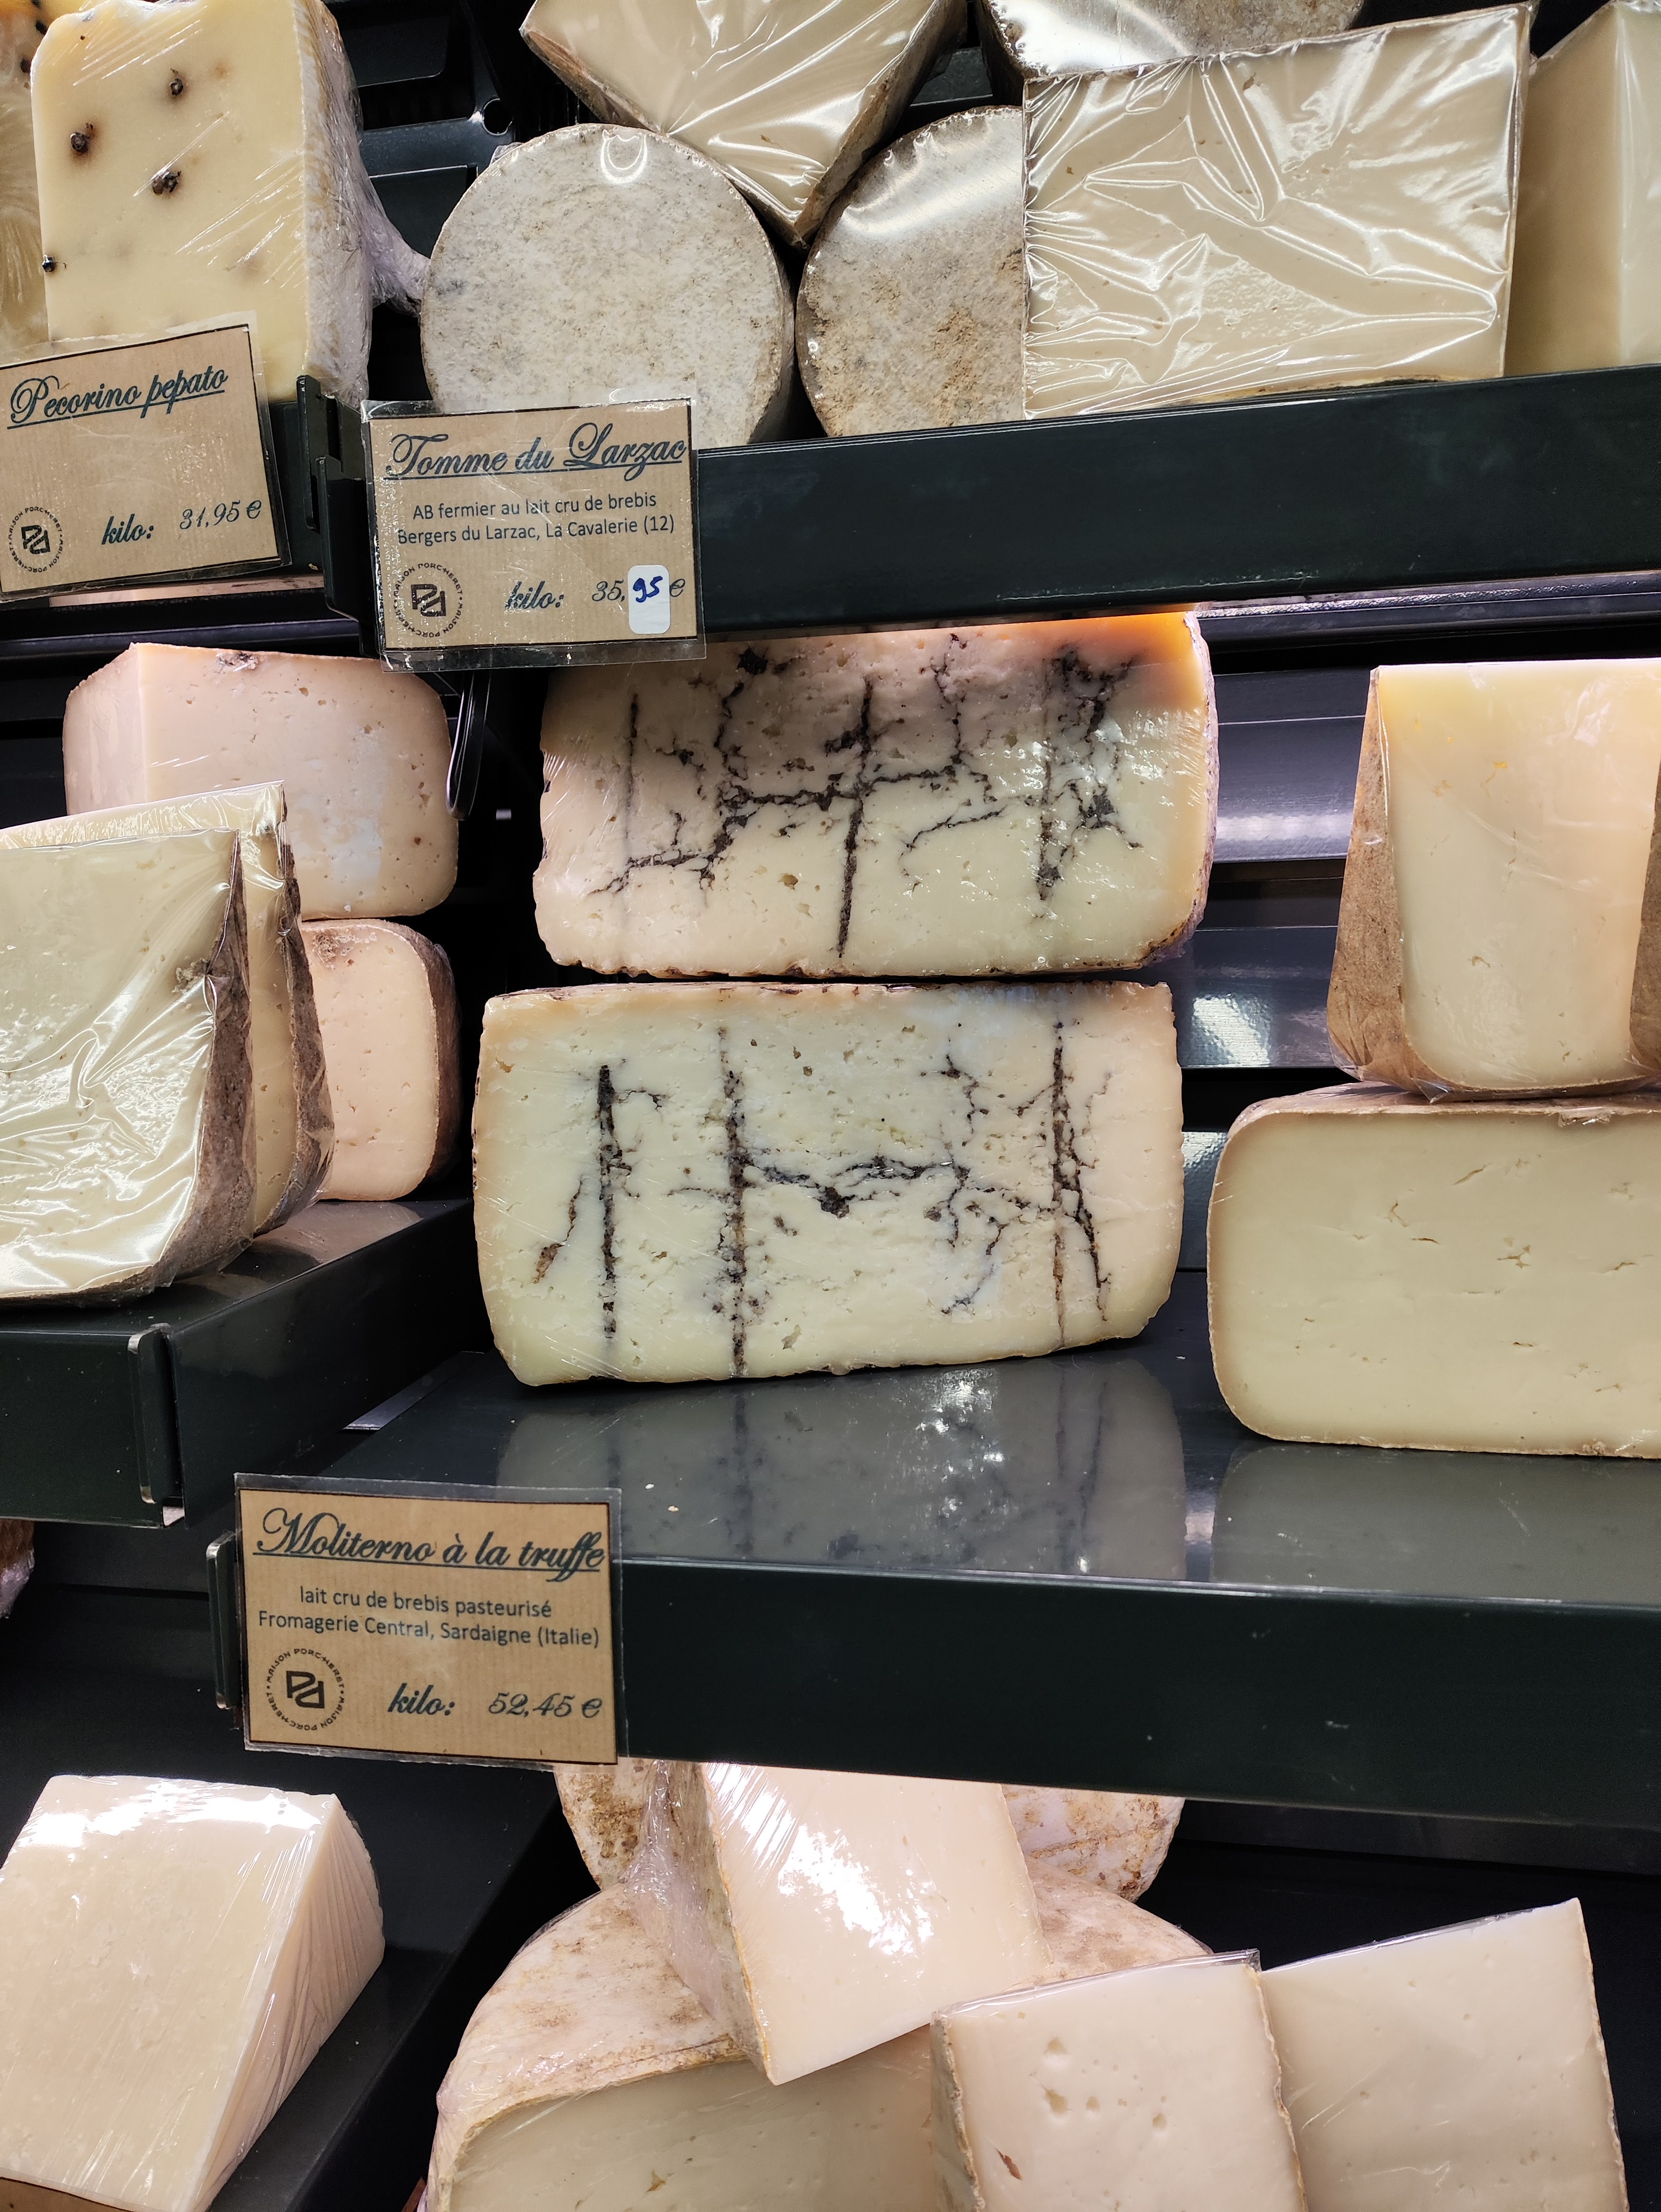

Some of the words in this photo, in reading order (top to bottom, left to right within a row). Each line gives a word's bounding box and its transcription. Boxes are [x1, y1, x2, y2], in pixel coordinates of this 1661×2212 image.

[11, 376, 141, 424] Pecorino
[140, 365, 228, 418] pepato
[386, 434, 507, 477] Tomme
[515, 437, 554, 470] du
[564, 422, 686, 481] Larzac
[413, 504, 433, 520] AB
[439, 501, 496, 518] fermier
[501, 501, 520, 515] au
[526, 499, 550, 515] lait
[554, 500, 580, 513] cru
[585, 495, 603, 511] de
[608, 492, 656, 509] brebis
[101, 514, 154, 544] kilo:
[398, 529, 456, 547] Bergers
[462, 523, 480, 542] du
[487, 522, 540, 542] Larzac,
[546, 524, 562, 537] La
[568, 517, 638, 537] Cavalerie
[644, 516, 675, 534] (12)
[505, 581, 565, 609] kilo:
[257, 1508, 435, 1563] Moliterno
[443, 1534, 467, 1564] à
[476, 1531, 510, 1568] la
[519, 1531, 606, 1582] truffe
[299, 1586, 326, 1604] lait
[332, 1590, 360, 1607] cru
[366, 1590, 387, 1609] de
[394, 1592, 449, 1613] brebis
[456, 1599, 553, 1619] pasteurisé
[259, 1611, 359, 1633] Fromagerie
[365, 1616, 434, 1640] Central,
[441, 1623, 532, 1646] Sardaigne
[537, 1627, 599, 1649] (Italie)
[388, 1683, 455, 1715] kilo:
